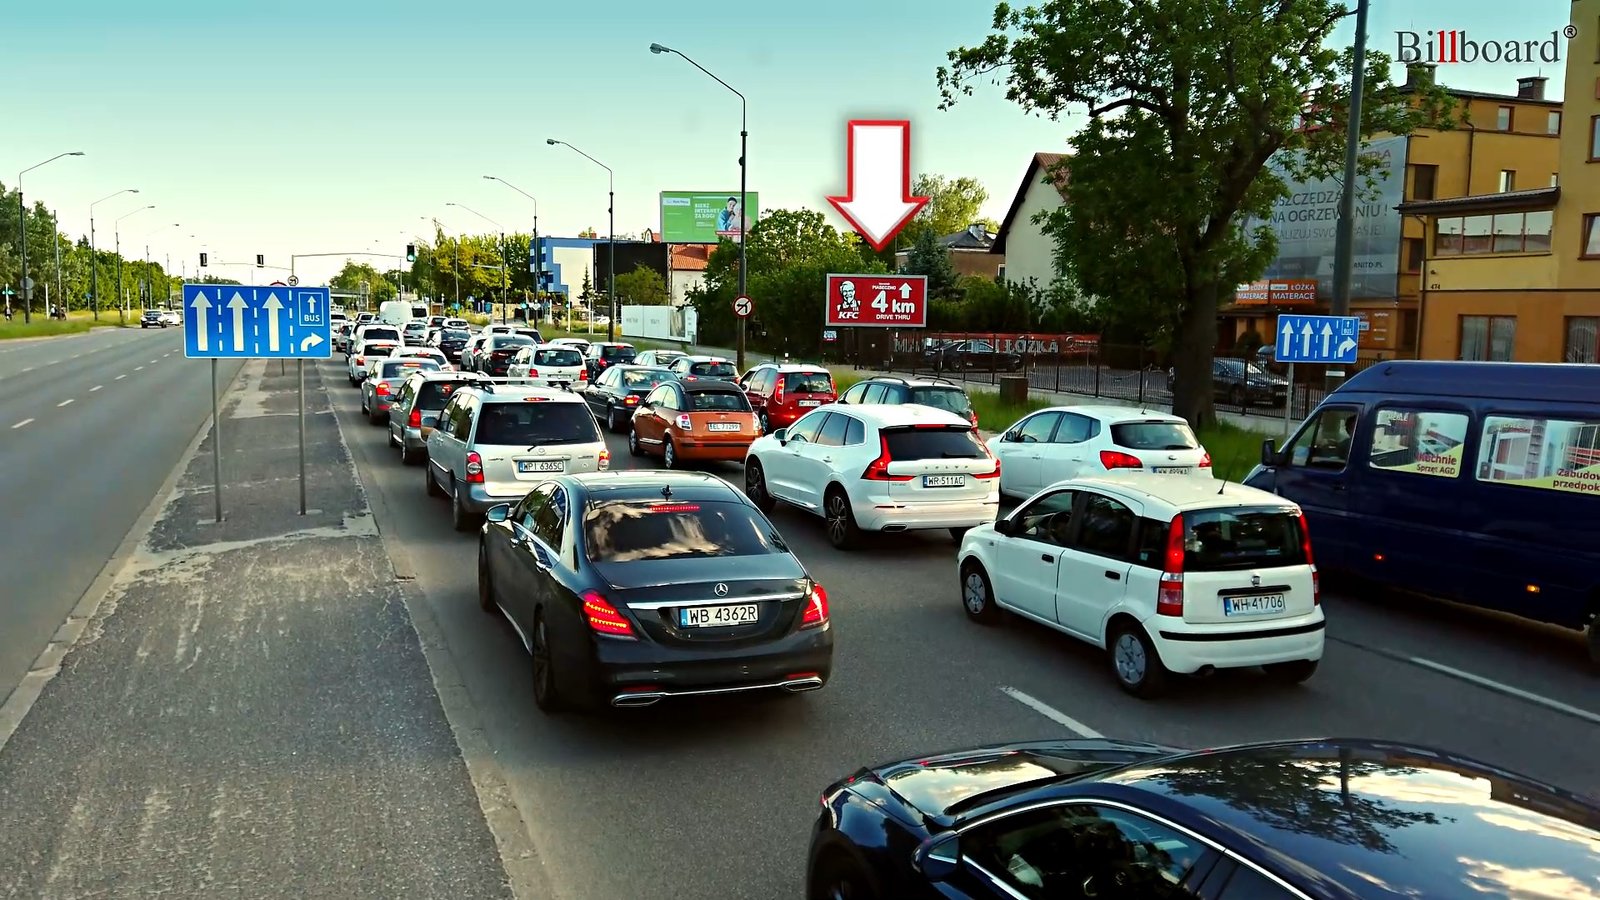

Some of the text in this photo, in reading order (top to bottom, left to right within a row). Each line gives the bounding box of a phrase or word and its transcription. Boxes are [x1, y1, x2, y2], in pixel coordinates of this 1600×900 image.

[1272, 292, 1315, 300] MATERACE
[871, 290, 915, 313] 4 km
[304, 314, 320, 322] BUS
[1439, 466, 1456, 475] AGD
[928, 475, 963, 485] WR 511AC
[1232, 596, 1283, 612] WH 41706
[689, 606, 756, 624] WB 4362R
